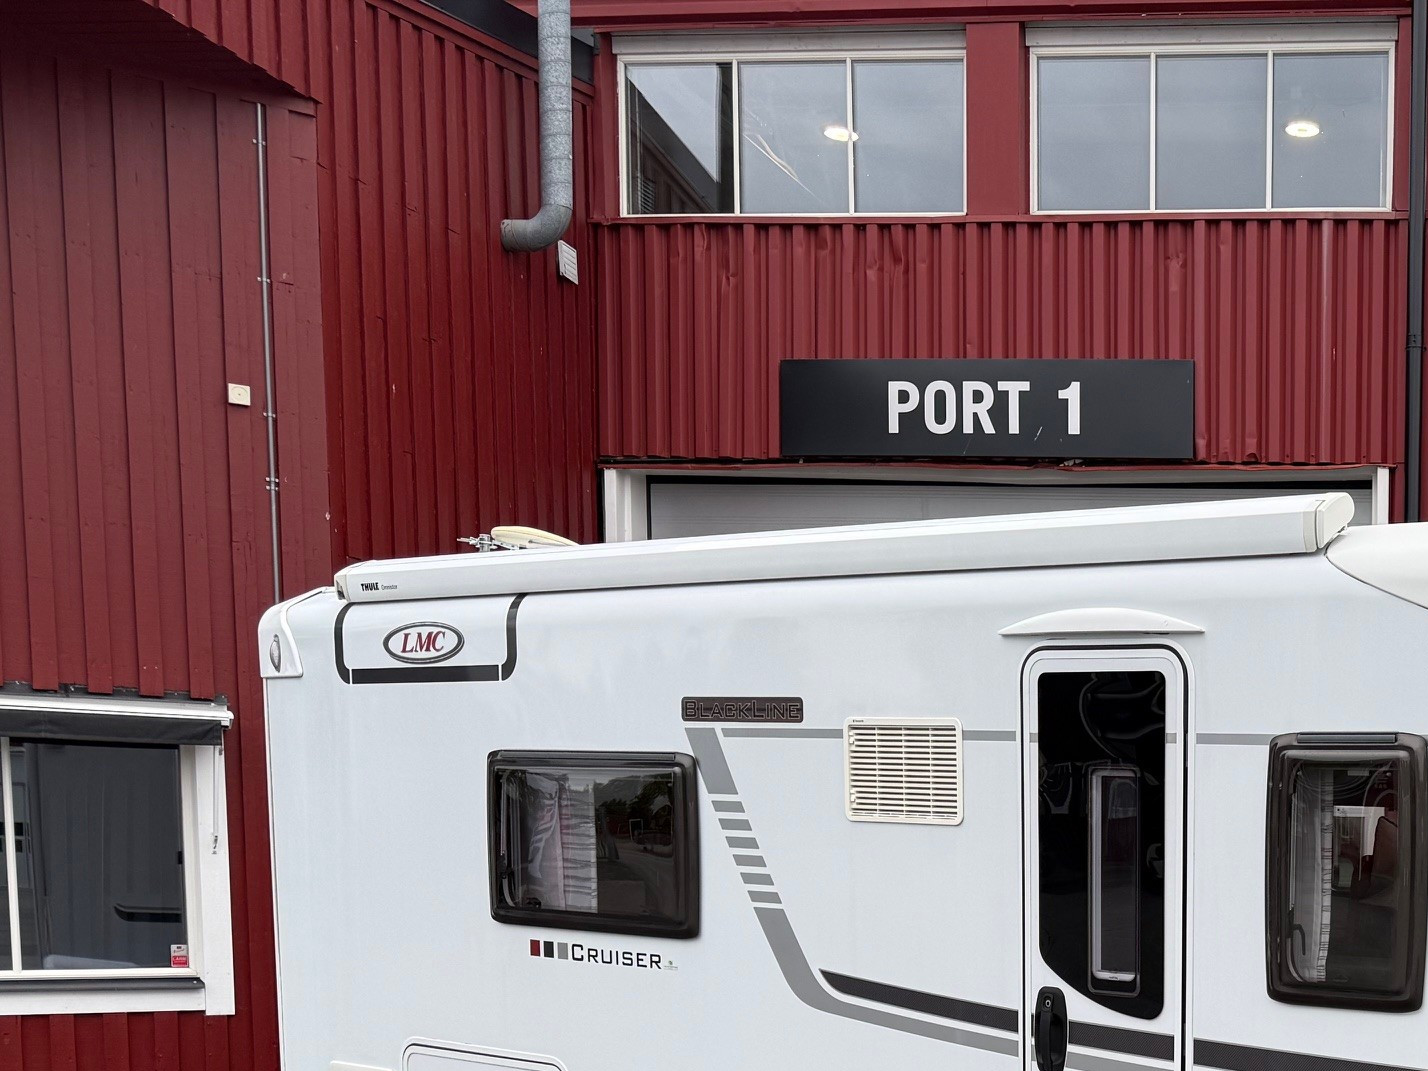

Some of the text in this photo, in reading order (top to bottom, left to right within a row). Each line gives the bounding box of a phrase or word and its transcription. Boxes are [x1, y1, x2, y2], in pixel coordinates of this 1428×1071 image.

[888, 380, 1081, 434] PORT 1
[360, 582, 380, 592] THULE
[400, 630, 446, 653] LMC
